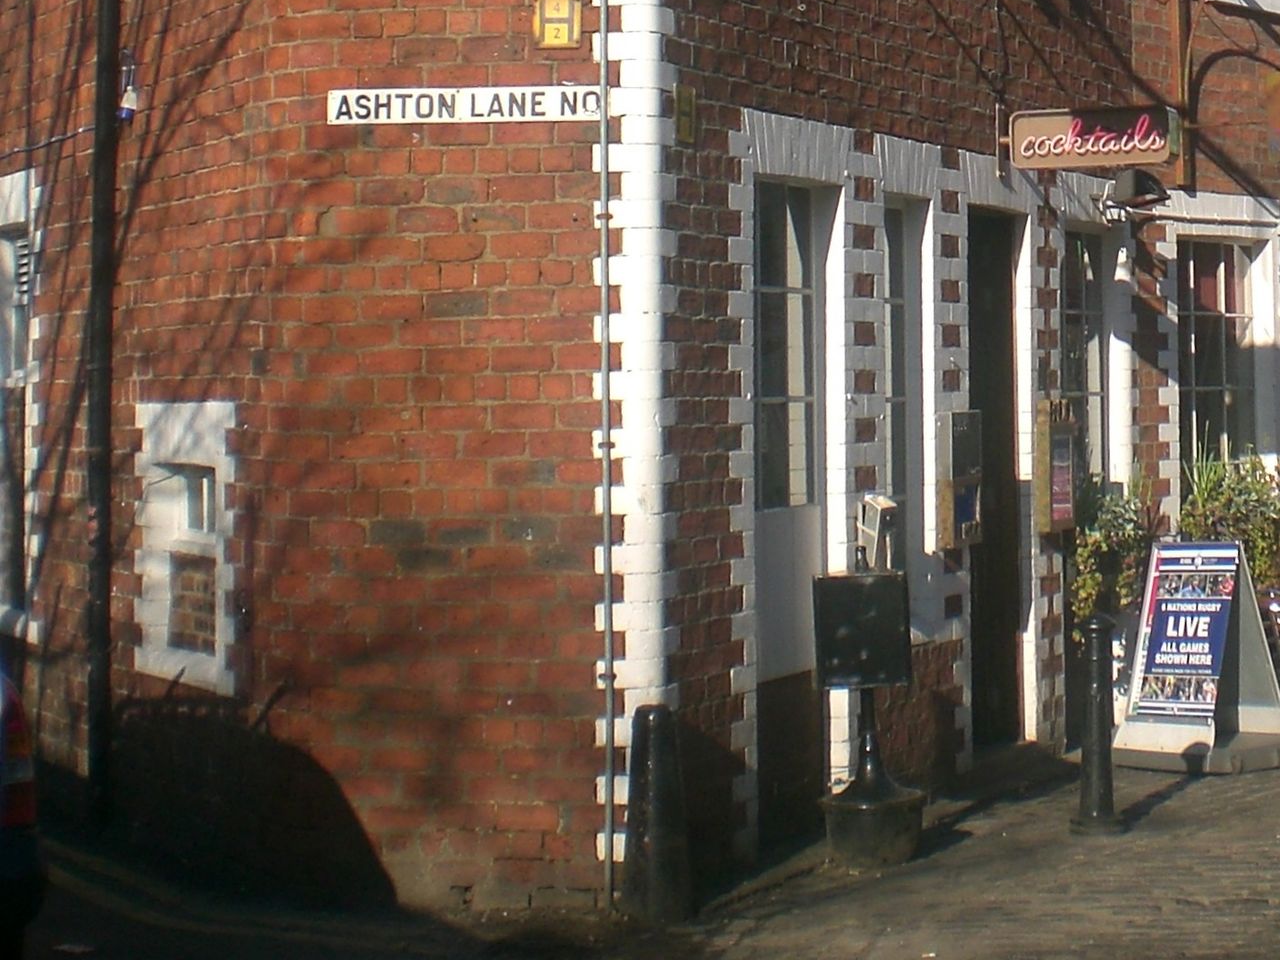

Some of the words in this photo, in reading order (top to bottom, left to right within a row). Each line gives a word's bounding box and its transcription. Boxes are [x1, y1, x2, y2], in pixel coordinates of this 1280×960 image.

[553, 27, 560, 39] 2
[334, 94, 456, 121] ASHTON
[470, 92, 546, 117] LANE
[1020, 114, 1165, 157] cocktails
[1166, 615, 1211, 637] LIVE
[1160, 641, 1178, 653] ALL
[1179, 642, 1210, 653] GAMES
[1154, 652, 1188, 664] SHOWN
[1188, 654, 1213, 666] HERE
